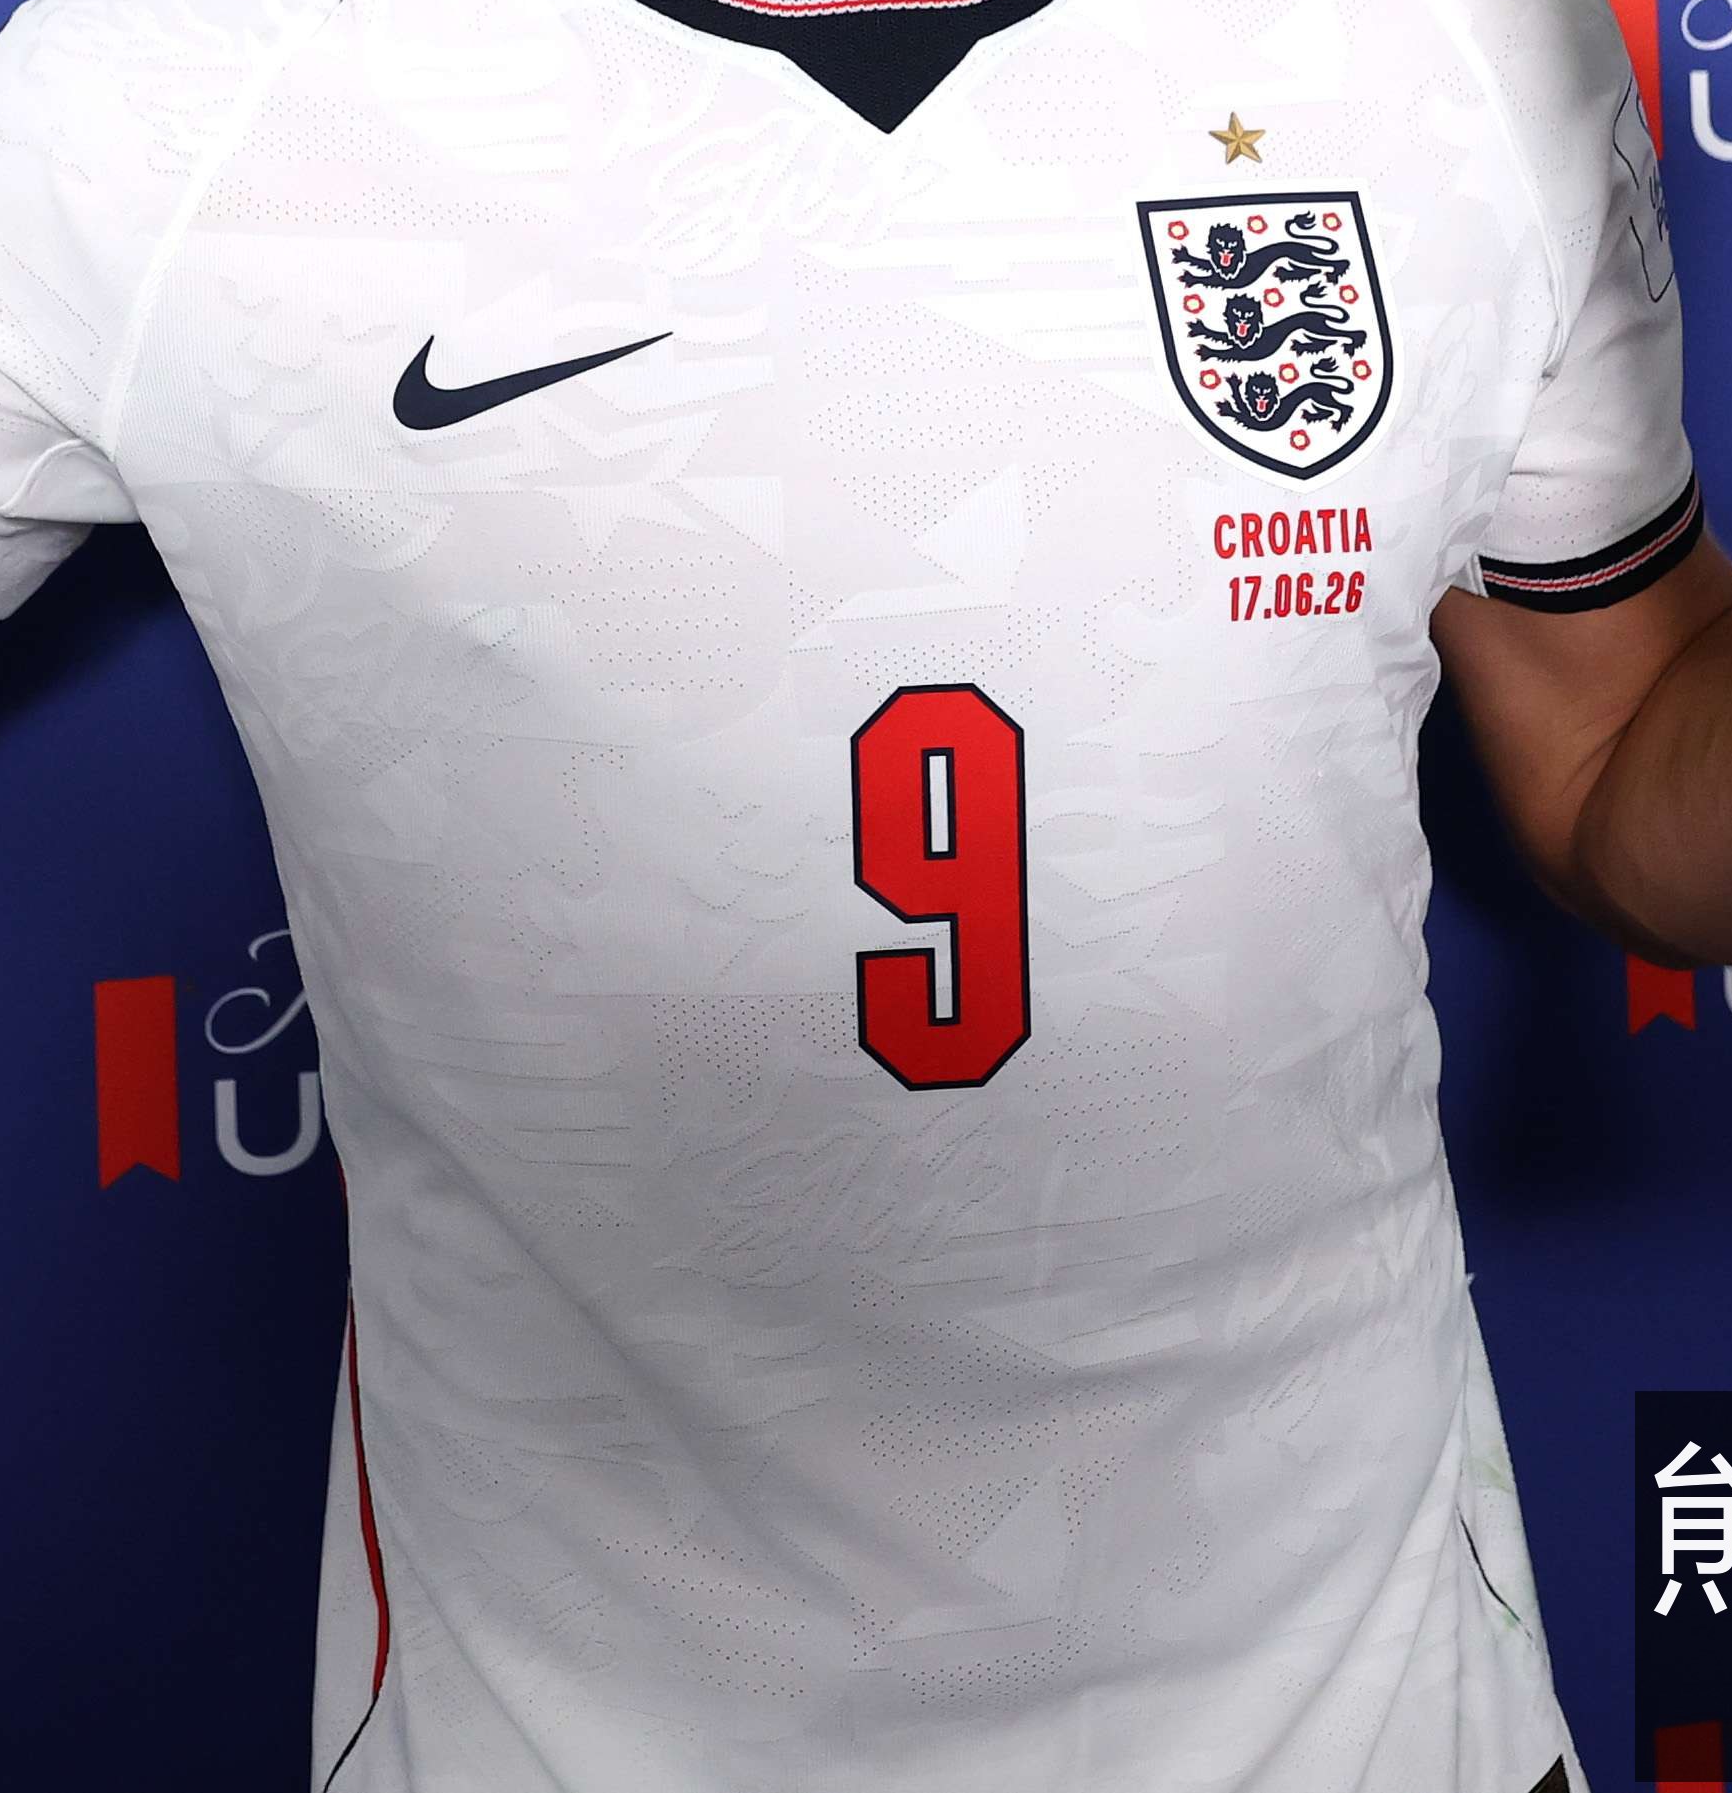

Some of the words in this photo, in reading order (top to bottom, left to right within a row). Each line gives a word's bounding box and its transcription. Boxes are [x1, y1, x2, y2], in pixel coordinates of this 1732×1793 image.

[1214, 507, 1373, 560] CROATIA
[1229, 570, 1366, 622] 17.06.26
[850, 682, 1032, 1092] 9
